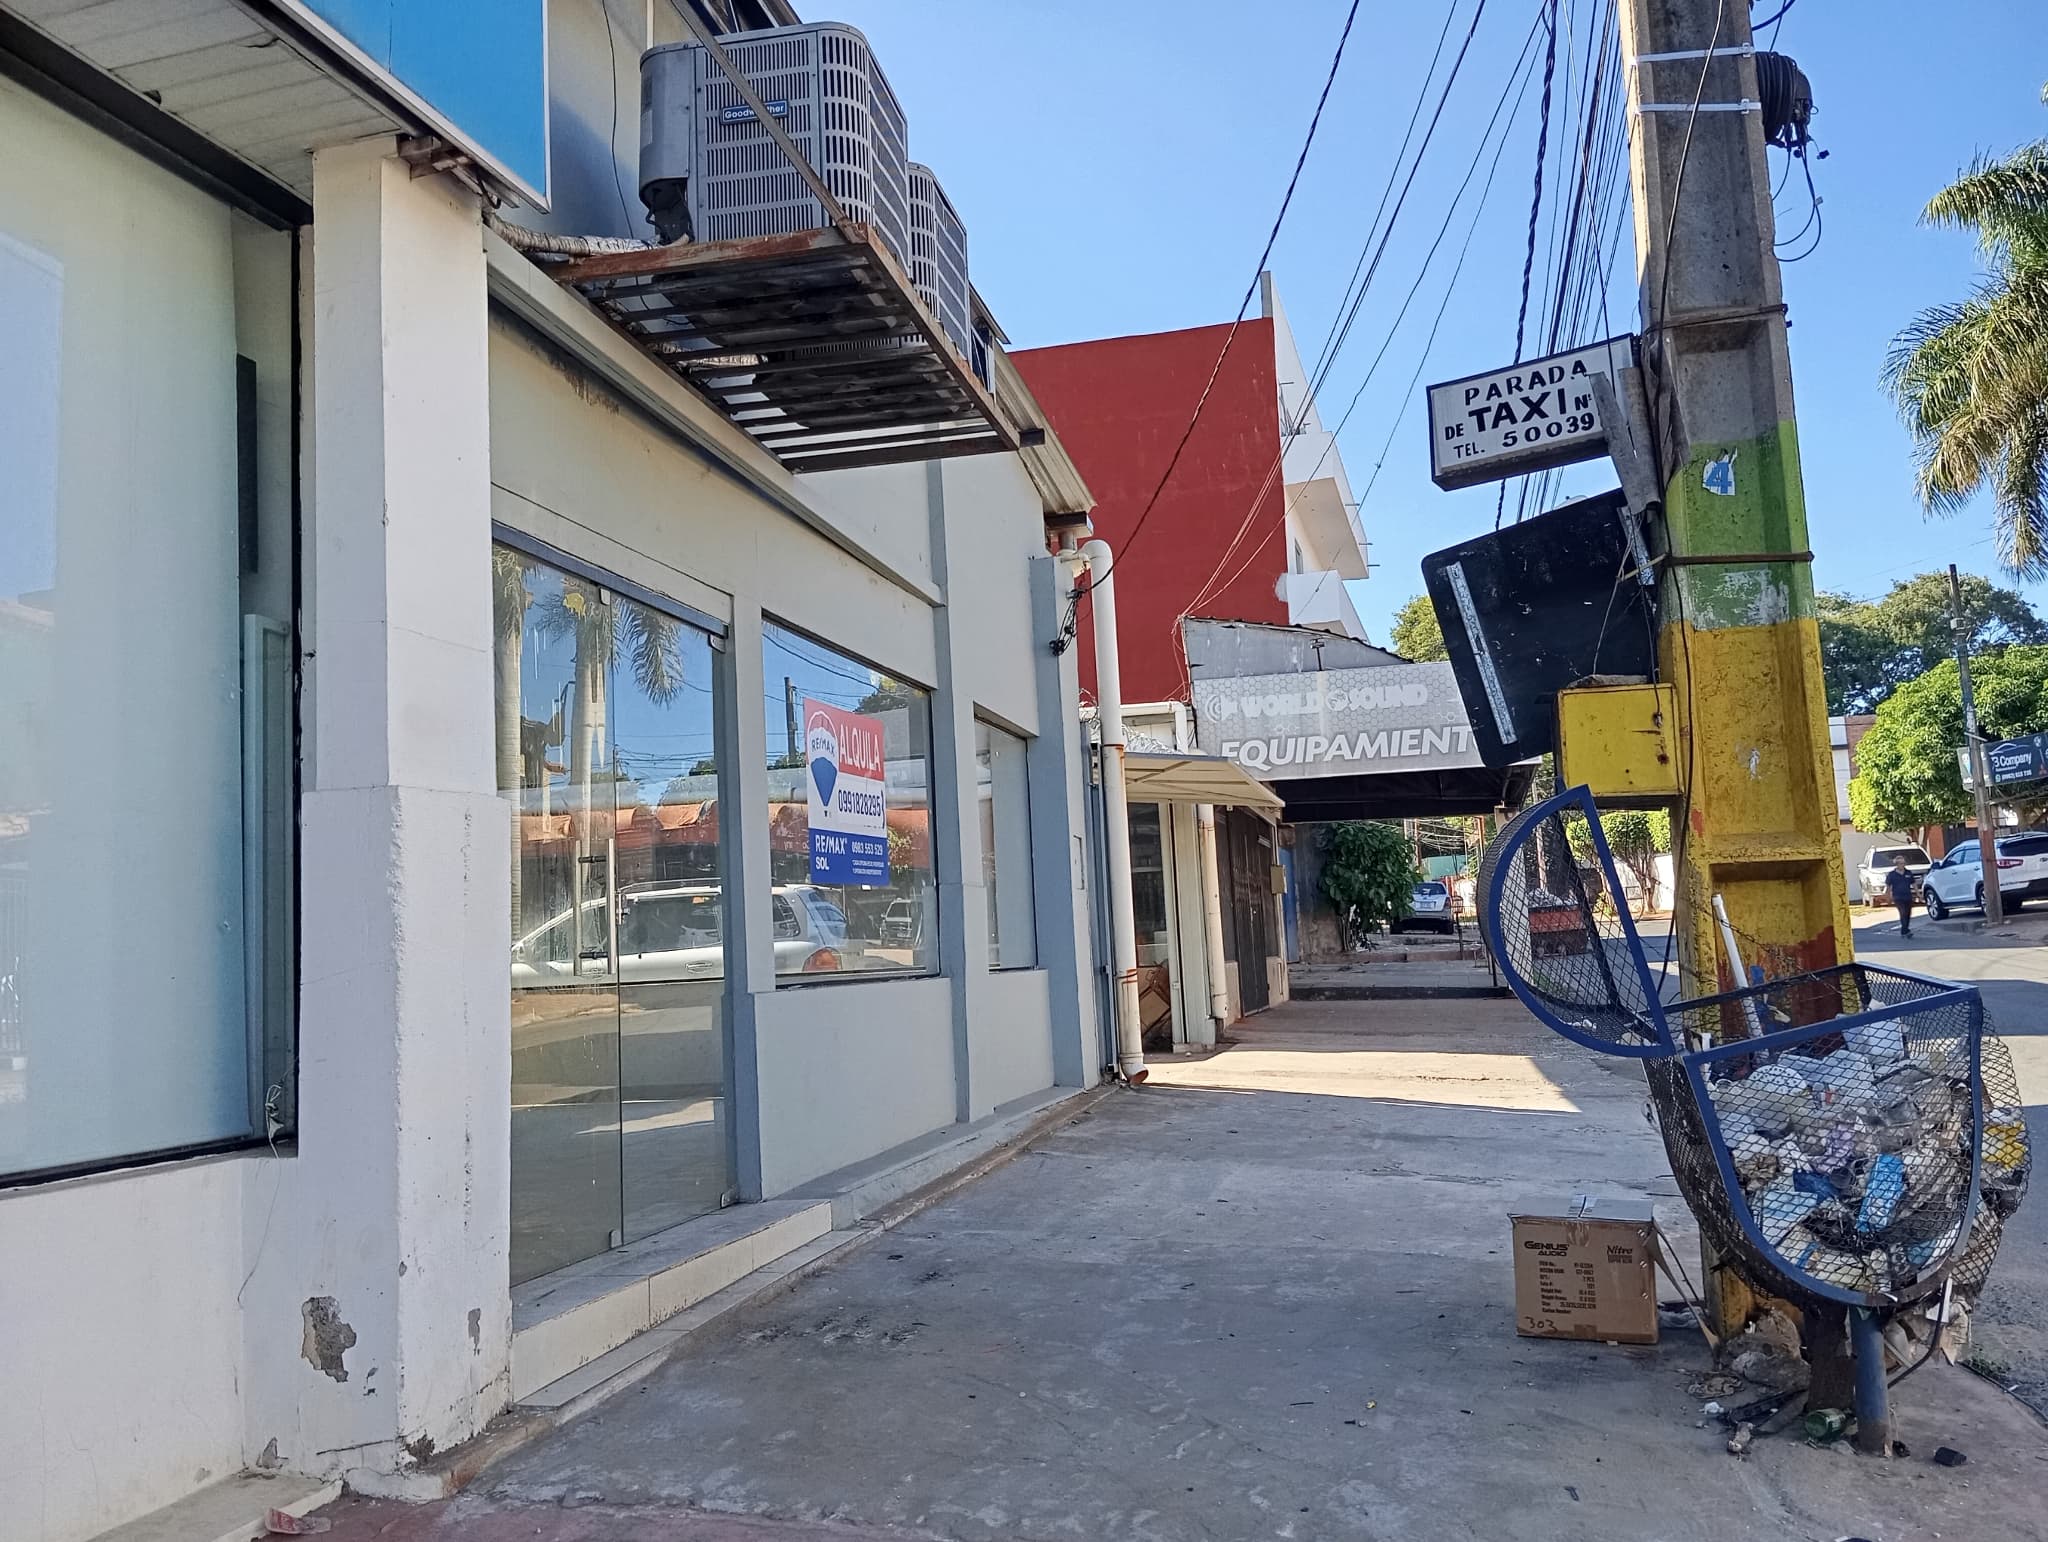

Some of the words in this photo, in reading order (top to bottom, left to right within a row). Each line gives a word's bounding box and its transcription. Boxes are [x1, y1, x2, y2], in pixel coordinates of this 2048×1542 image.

[725, 105, 784, 119] Goodwher
[1464, 359, 1588, 406] PARADA
[1445, 423, 1464, 441] DE
[1468, 388, 1567, 433] TAXI
[1453, 441, 1485, 459] TEL.
[1502, 412, 1595, 448] 50039
[1705, 462, 1733, 494] 4
[1348, 683, 1429, 712] SOUND
[811, 737, 835, 757] RE/MAX
[839, 724, 881, 772] ALQUILA
[1220, 725, 1479, 772] EQUIPAMIENT
[2000, 752, 2032, 767] Company
[838, 788, 882, 817] 0991828295
[815, 834, 846, 856] RE/MAX
[815, 855, 830, 871] SOL
[1525, 1316, 1558, 1333] 303
